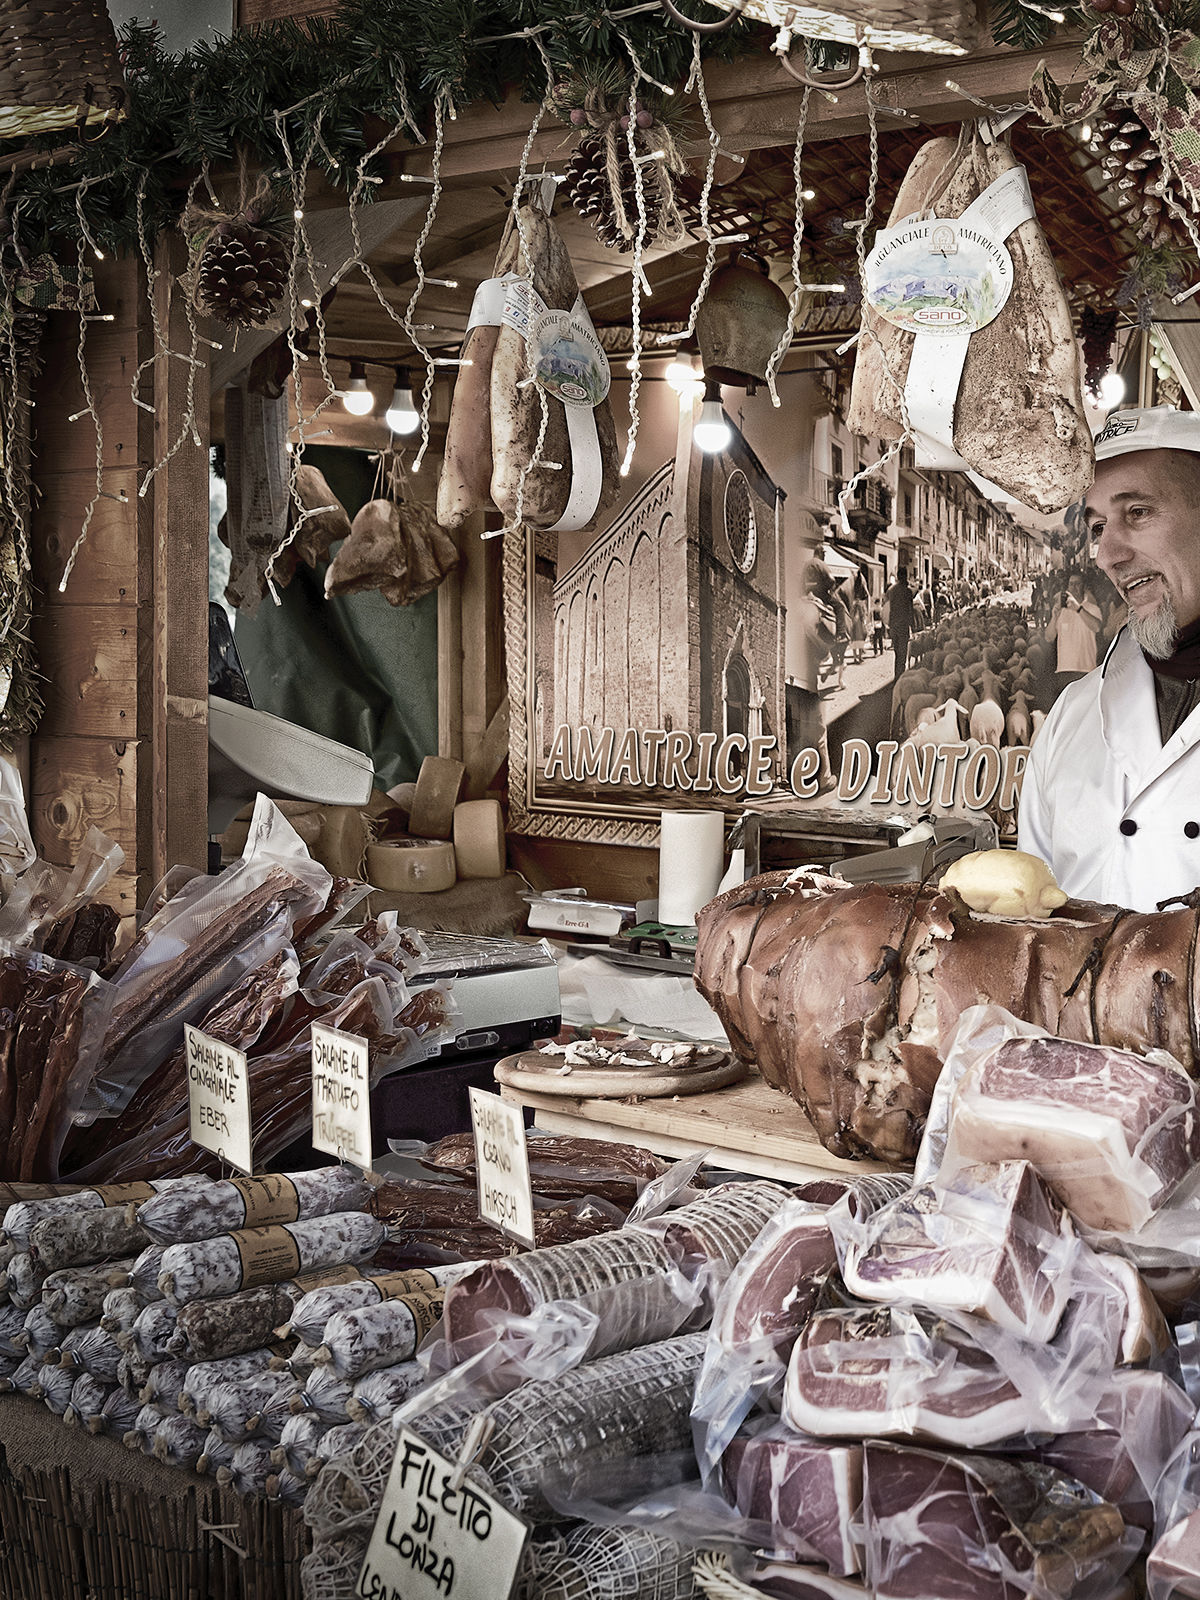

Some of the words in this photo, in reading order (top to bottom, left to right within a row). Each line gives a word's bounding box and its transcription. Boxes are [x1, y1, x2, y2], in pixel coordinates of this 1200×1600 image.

[878, 227, 930, 261] GUANCIALE
[958, 227, 1007, 275] AMATRICIANO
[918, 310, 961, 320] sano
[543, 724, 778, 799] AMATRICE
[790, 747, 821, 799] e
[190, 1064, 236, 1104] CINGHIALE
[227, 1055, 240, 1080] AL
[351, 1051, 364, 1080] AL
[314, 1074, 359, 1112] TARTUFO
[200, 1104, 231, 1137] EBER
[484, 1182, 518, 1226] HIRSCH
[401, 1440, 492, 1541] FILETTO
[412, 1502, 436, 1542] DI
[385, 1511, 455, 1597] LONZA
